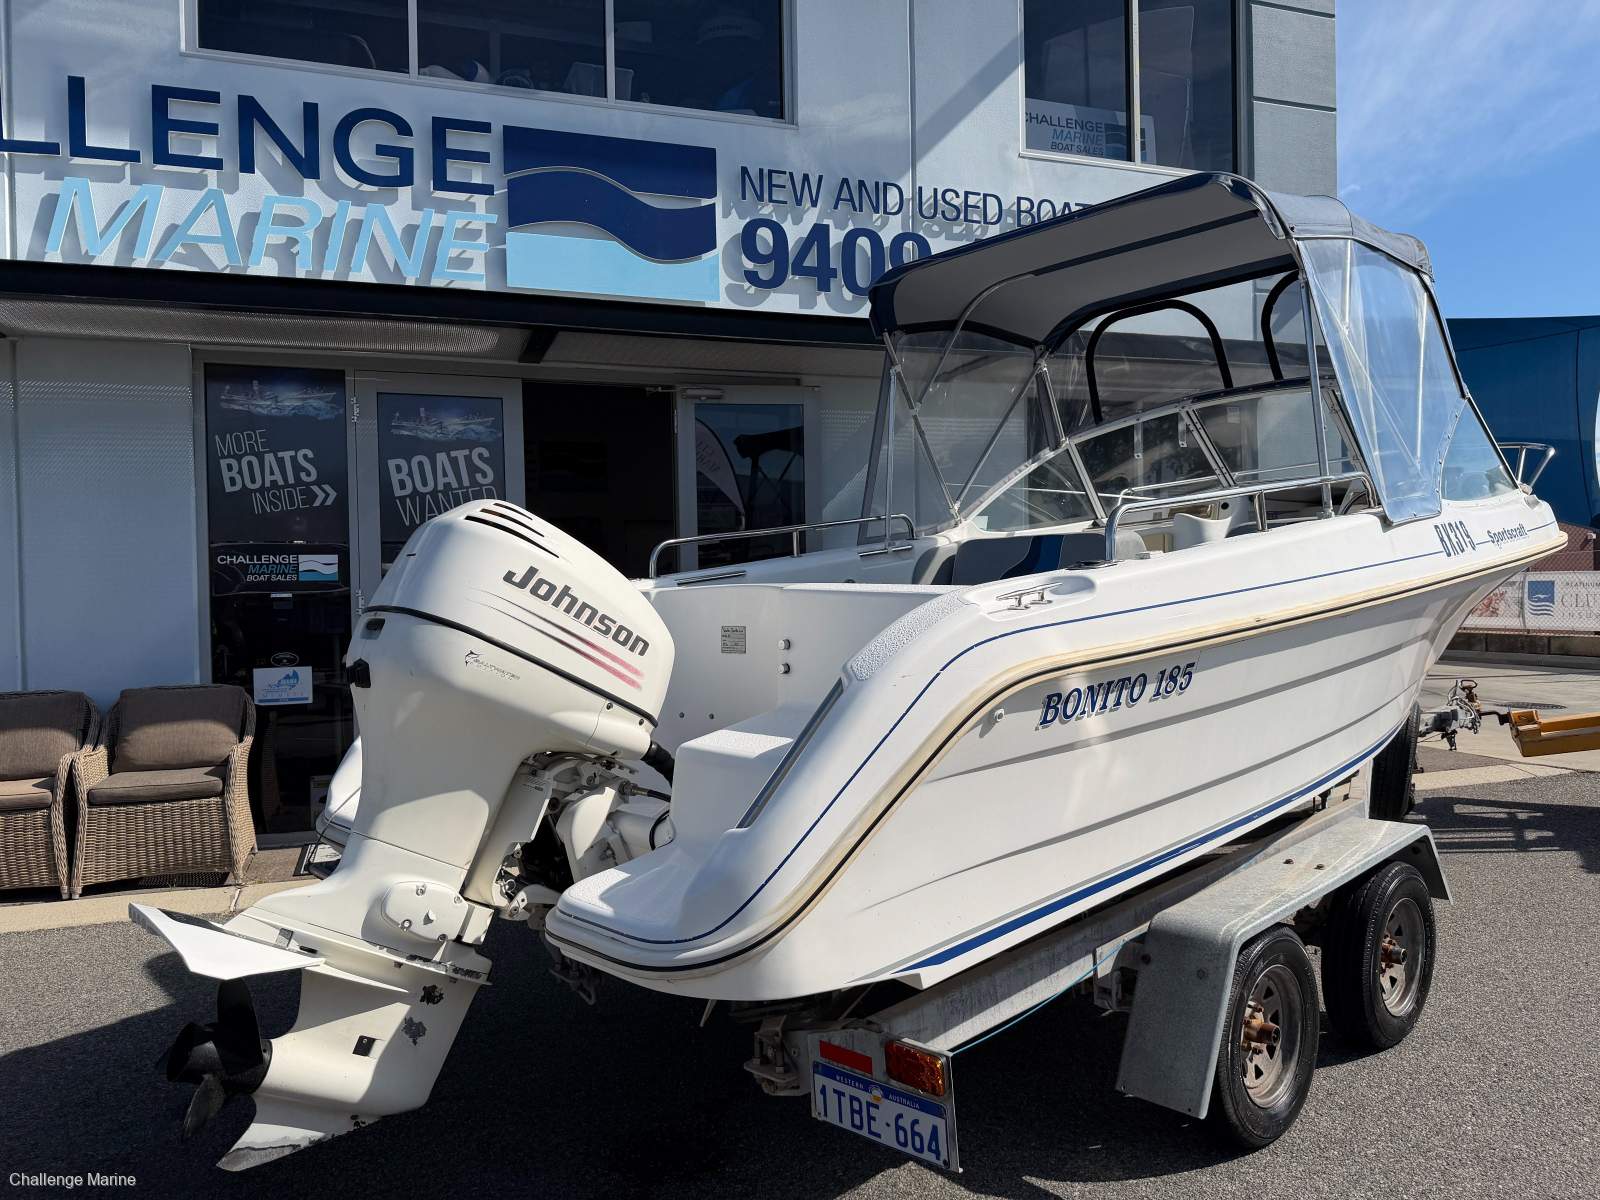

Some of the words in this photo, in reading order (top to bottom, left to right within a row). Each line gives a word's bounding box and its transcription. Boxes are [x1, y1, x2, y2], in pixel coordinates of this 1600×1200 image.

[1050, 141, 1074, 151] BOAT
[1076, 145, 1104, 156] SALES
[1052, 128, 1104, 147] MARINE
[740, 165, 823, 208] NEW
[833, 177, 904, 216] AND
[917, 187, 1003, 227] USED
[45, 176, 498, 283] MARINE
[215, 429, 269, 456] MORE
[219, 449, 318, 493] BOATS
[387, 447, 494, 497] BOATS
[251, 486, 308, 514] INSIDE
[1487, 522, 1528, 544] Sportscraft
[217, 554, 298, 565] CHALLENGE
[248, 564, 299, 574] MARINE
[246, 574, 269, 582] BOAT
[502, 566, 650, 657] Johnson
[1038, 672, 1149, 728] BONITO
[1152, 661, 1196, 699] 185
[835, 1074, 864, 1089] WESTERN
[888, 1093, 920, 1110] AUSTRALIA
